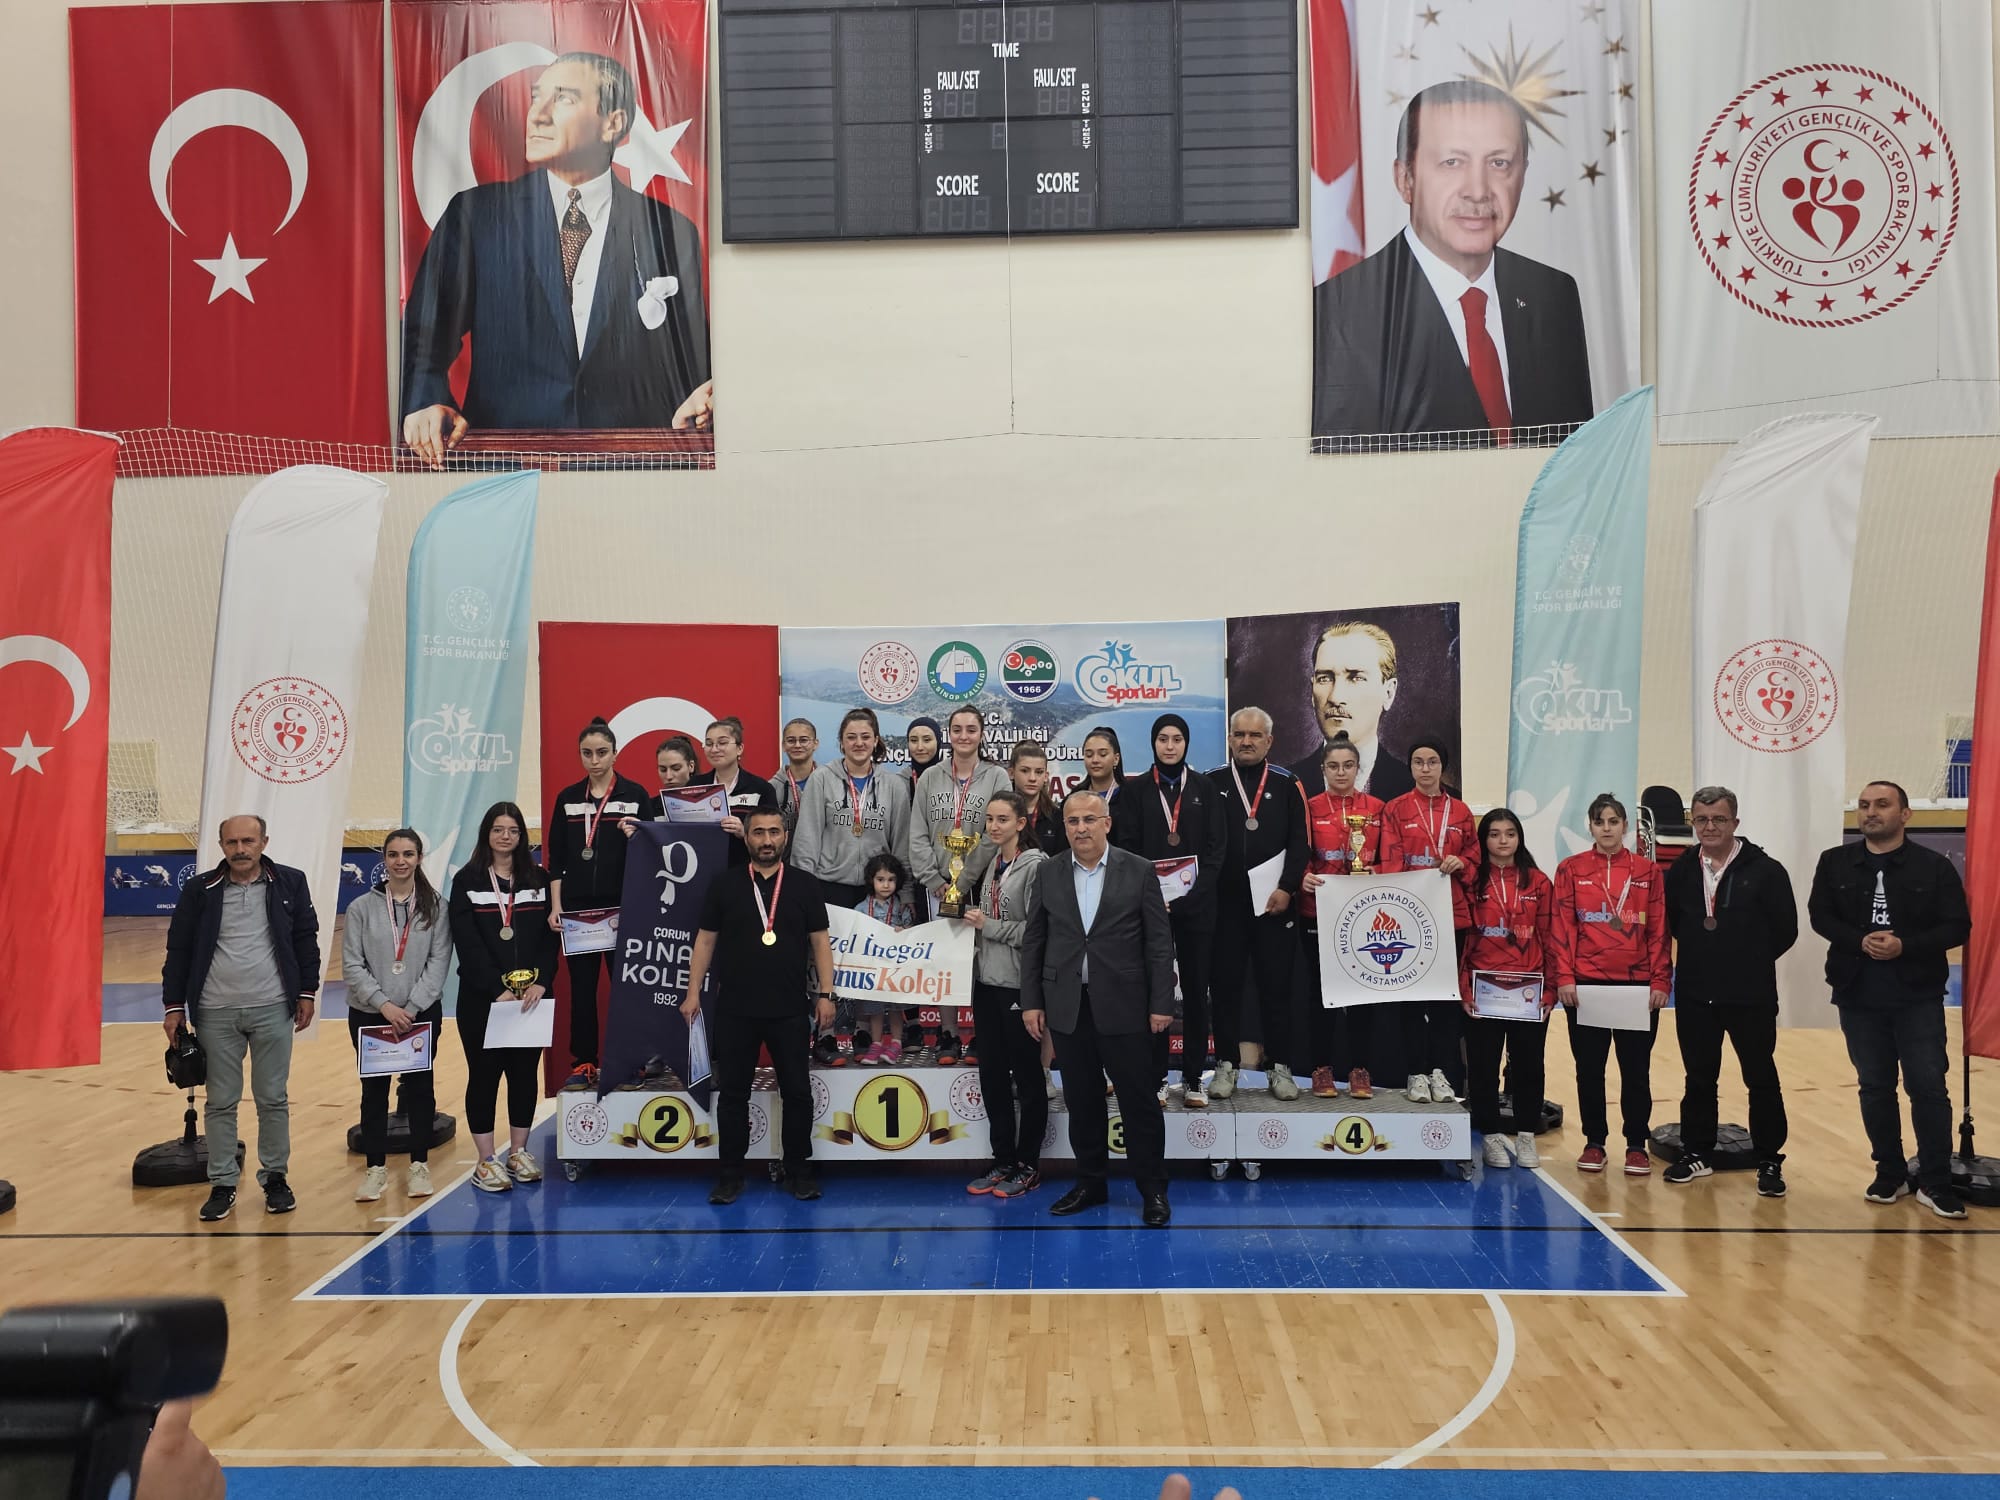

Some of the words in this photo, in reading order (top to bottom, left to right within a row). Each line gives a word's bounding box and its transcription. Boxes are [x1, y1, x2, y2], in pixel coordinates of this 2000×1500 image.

[992, 42, 1019, 58] TIME
[937, 70, 980, 90] FAUL/SET
[1033, 67, 1076, 87] FAUL/SET
[923, 88, 932, 119] BONUS
[1081, 83, 1090, 114] BONUS
[1798, 111, 1872, 135] GENÇLİK
[1873, 130, 1890, 152] VE
[1738, 117, 1796, 223] CUMHURİYETİ
[1886, 150, 1910, 194] SPOR
[936, 175, 979, 196] SCORE
[1036, 172, 1080, 193] SCORE
[1848, 199, 1910, 275] BAKANLIĞI
[1746, 224, 1804, 277] TÜRKİYE
[1608, 585, 1623, 596] VE
[423, 634, 444, 645] T.C.
[447, 636, 495, 648] GENÇLİK
[423, 647, 452, 657] SPOR
[455, 650, 509, 661] BAKANLIĞ
[1090, 664, 1182, 693] OKUL
[1017, 686, 1041, 694] 1966
[1106, 684, 1167, 703] Sporları
[983, 726, 1048, 743] VALİLİĞİ
[833, 813, 885, 830] COLEGE
[653, 926, 691, 941] ÇORUM
[1340, 911, 1356, 955] MUSTAFA
[1354, 894, 1378, 911] KAYA
[1381, 892, 1425, 919] ANADOLU
[1421, 919, 1433, 951] LİSESİ
[1366, 930, 1407, 942] MKAL
[625, 938, 694, 966] PINA
[829, 933, 857, 953] zel
[861, 933, 934, 964] İnegöl
[1375, 953, 1399, 962] 1987
[1359, 968, 1418, 986] KASTAMONU
[653, 992, 678, 1006] 1992
[878, 1087, 899, 1138] 1
[654, 1105, 679, 1144] 2
[1345, 1122, 1364, 1149] 4
